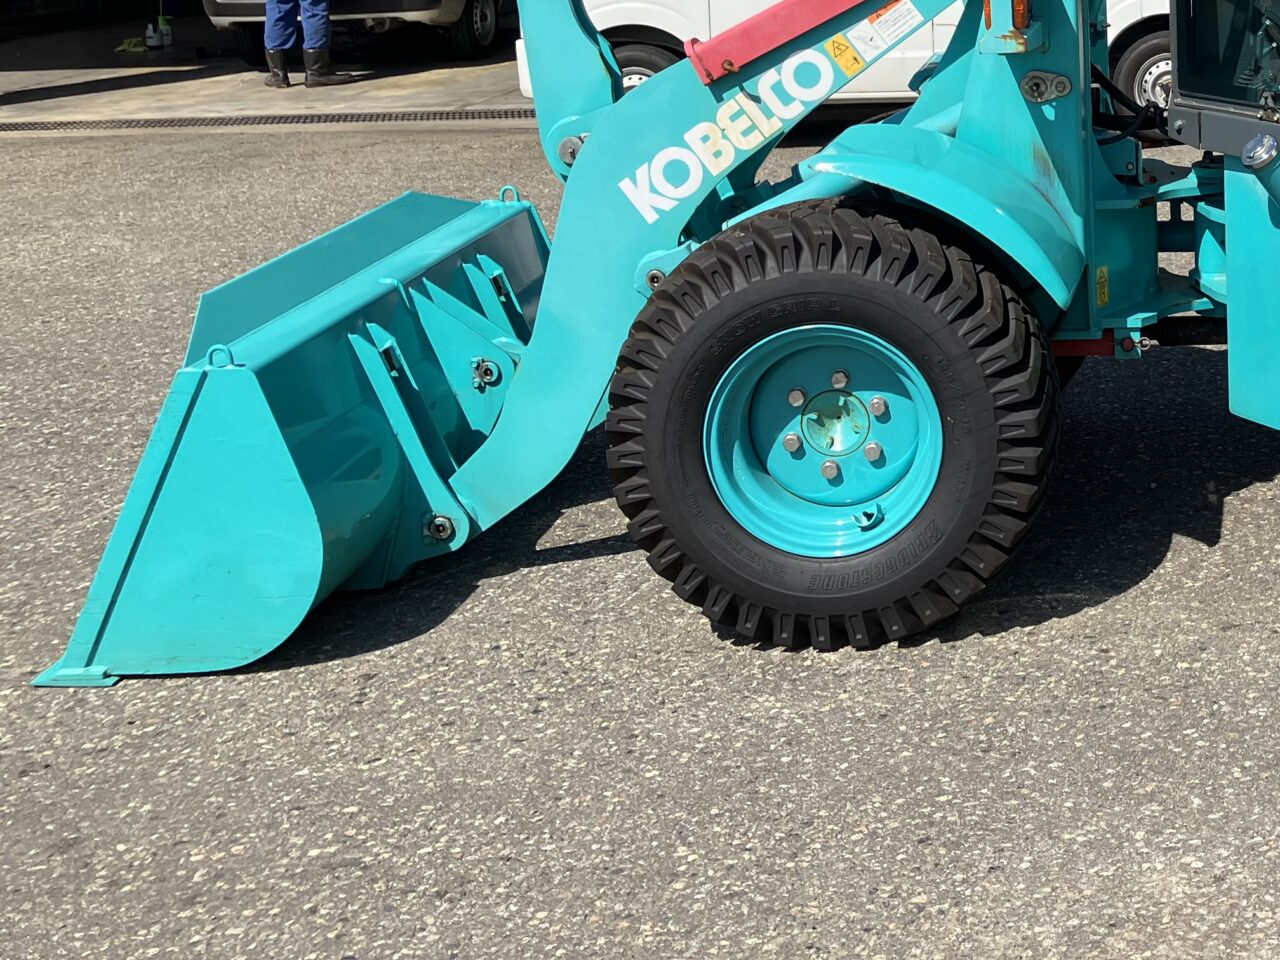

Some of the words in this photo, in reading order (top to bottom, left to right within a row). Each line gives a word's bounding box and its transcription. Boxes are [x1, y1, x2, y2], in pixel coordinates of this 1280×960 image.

[618, 49, 834, 225] KOBELCO
[709, 310, 761, 356] SNOW
[767, 297, 822, 318] GRIP
[807, 517, 945, 591] BRIDGESTONE
